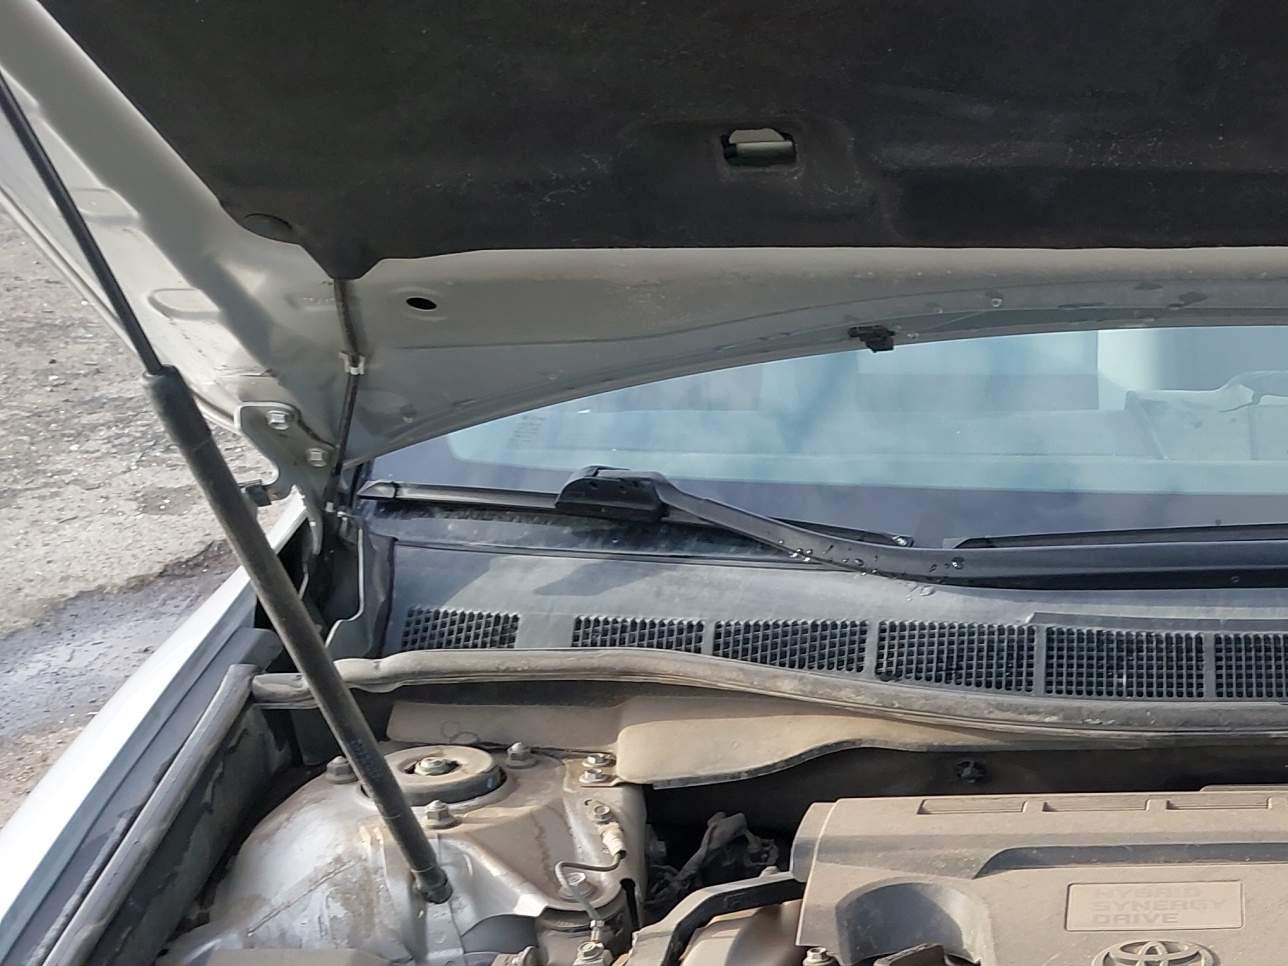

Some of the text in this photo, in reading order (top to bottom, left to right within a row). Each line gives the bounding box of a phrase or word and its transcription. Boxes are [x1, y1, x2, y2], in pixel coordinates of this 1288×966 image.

[1094, 886, 1202, 899] HYBRID
[1089, 898, 1226, 912] SYNERGY
[1091, 912, 1179, 925] DRIVE
